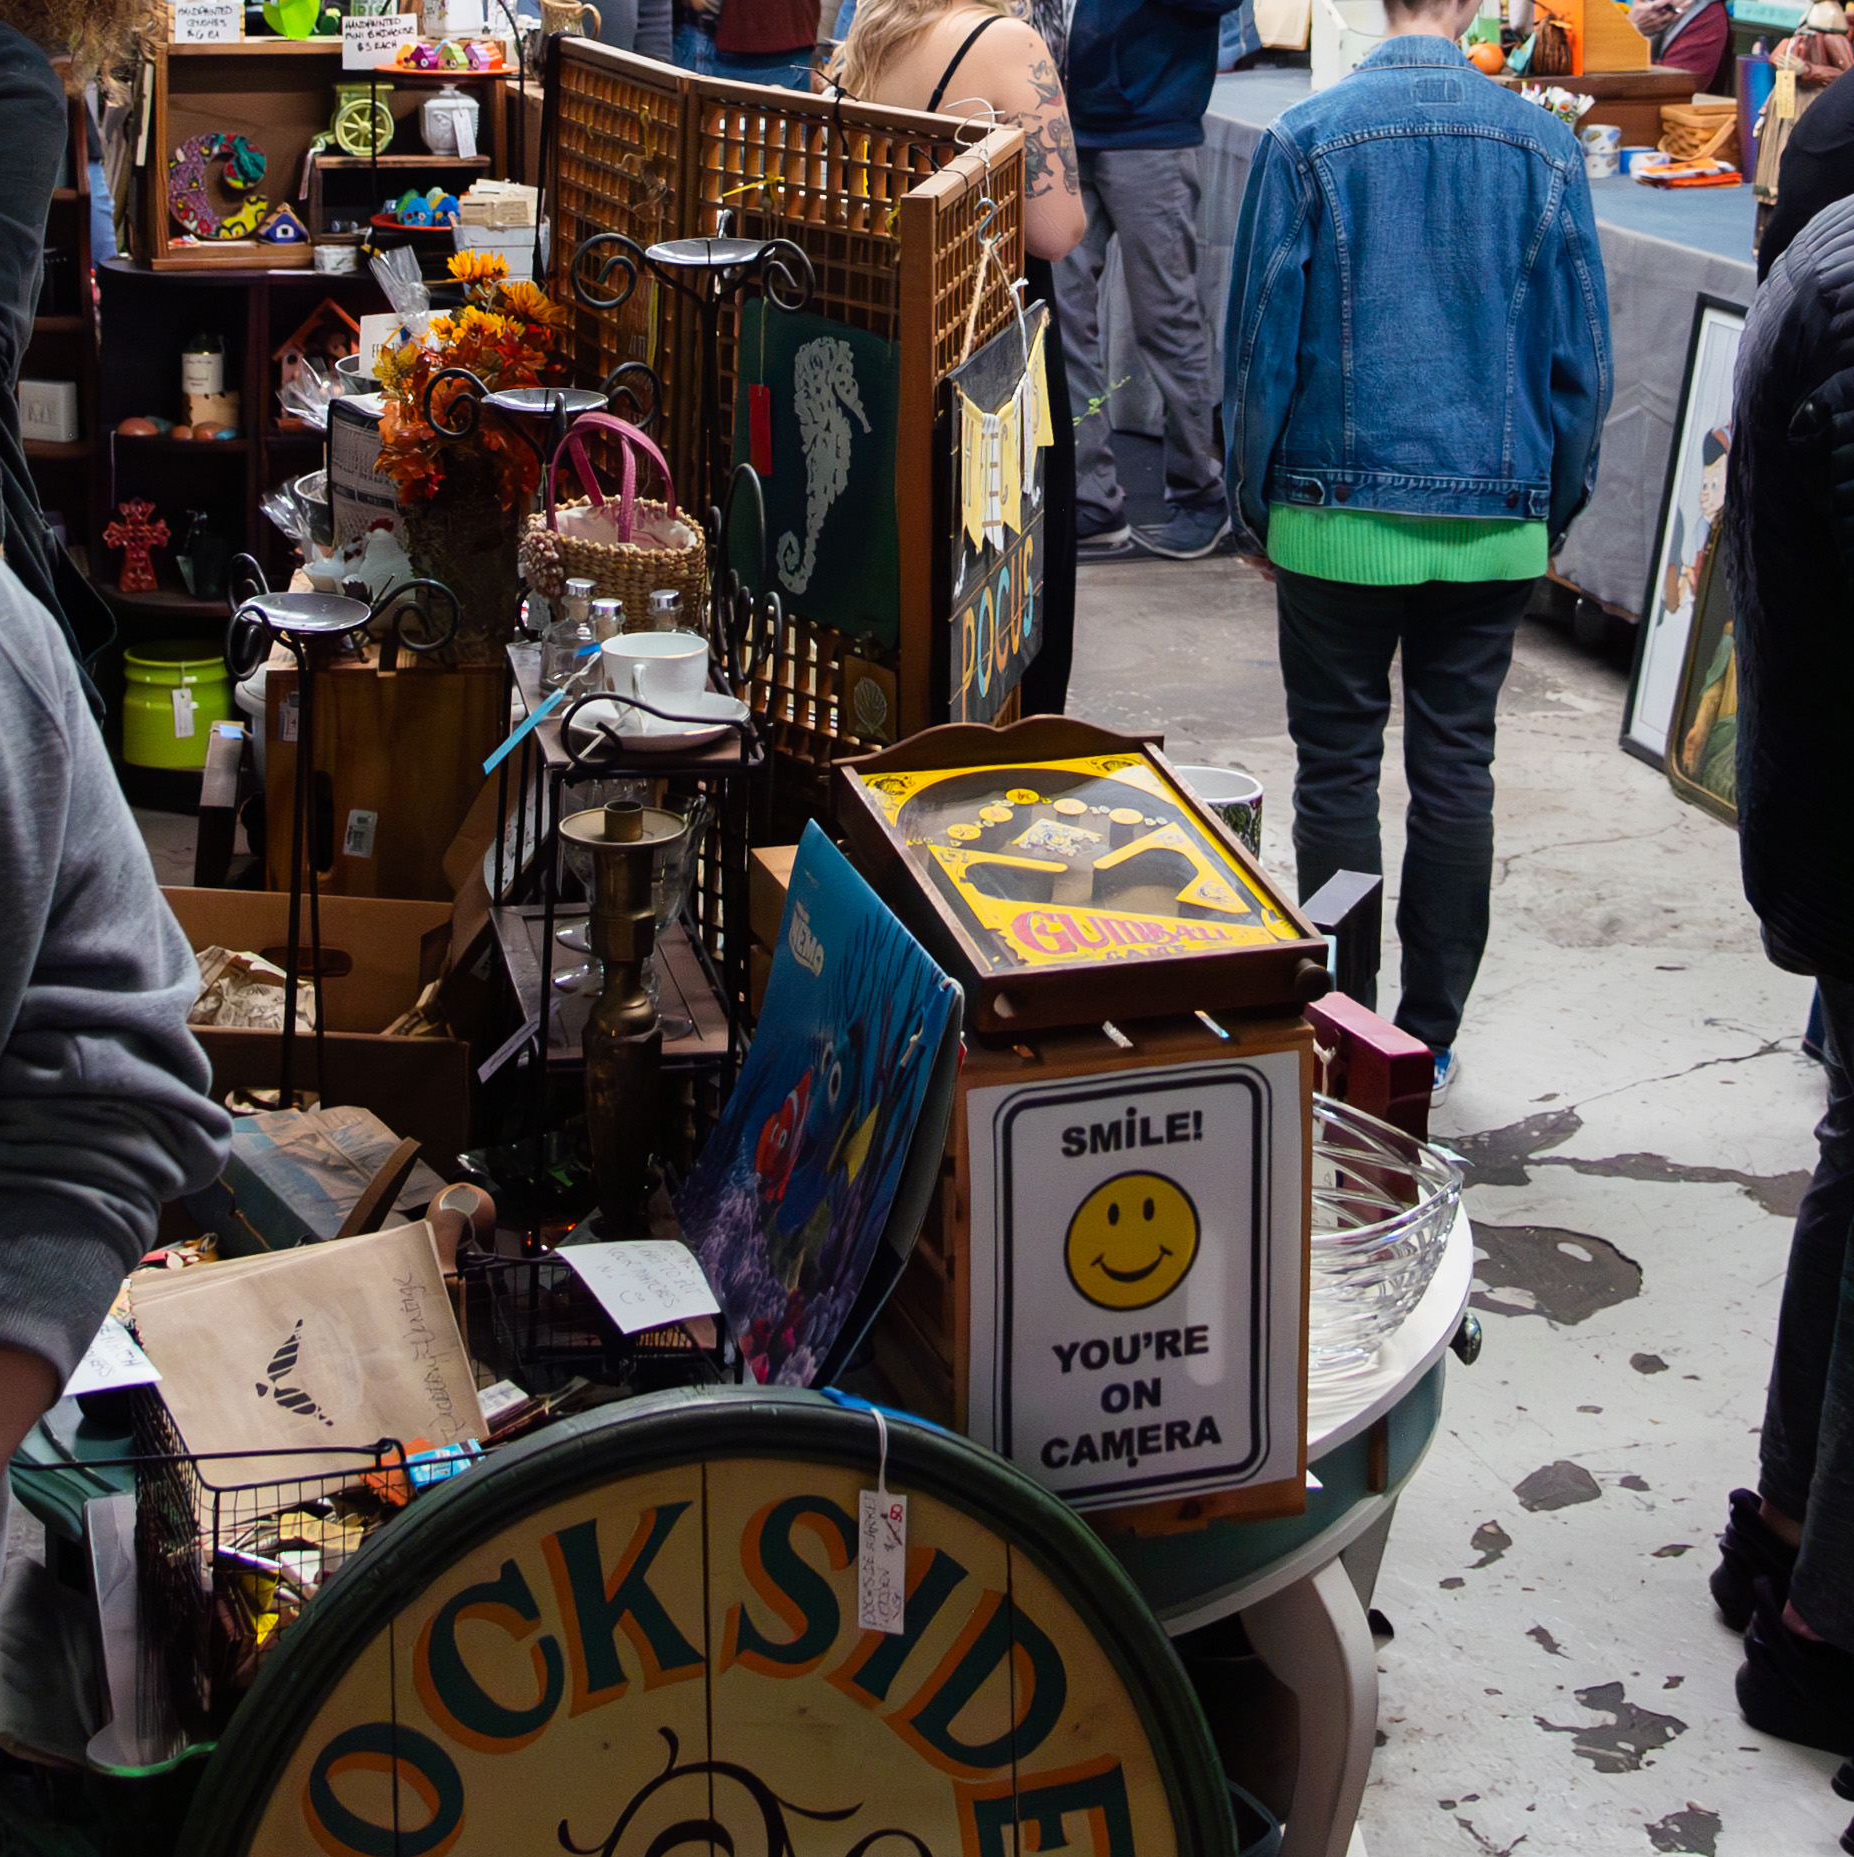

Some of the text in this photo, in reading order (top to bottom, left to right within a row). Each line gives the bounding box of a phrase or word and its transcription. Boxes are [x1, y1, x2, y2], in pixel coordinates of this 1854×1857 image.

[178, 5, 233, 17] HANDPAINTED
[345, 18, 401, 29] HANDPAINTED
[345, 30, 365, 40] MINI
[374, 41, 397, 51] EACH
[962, 533, 1034, 723] POCUS
[1012, 910, 1233, 957] GUMBALL
[1051, 1324, 1211, 1374] YOU'RE
[1100, 1379, 1163, 1414] ON
[1040, 1415, 1222, 1470] CAMERA
[303, 1500, 706, 1857] OCK
